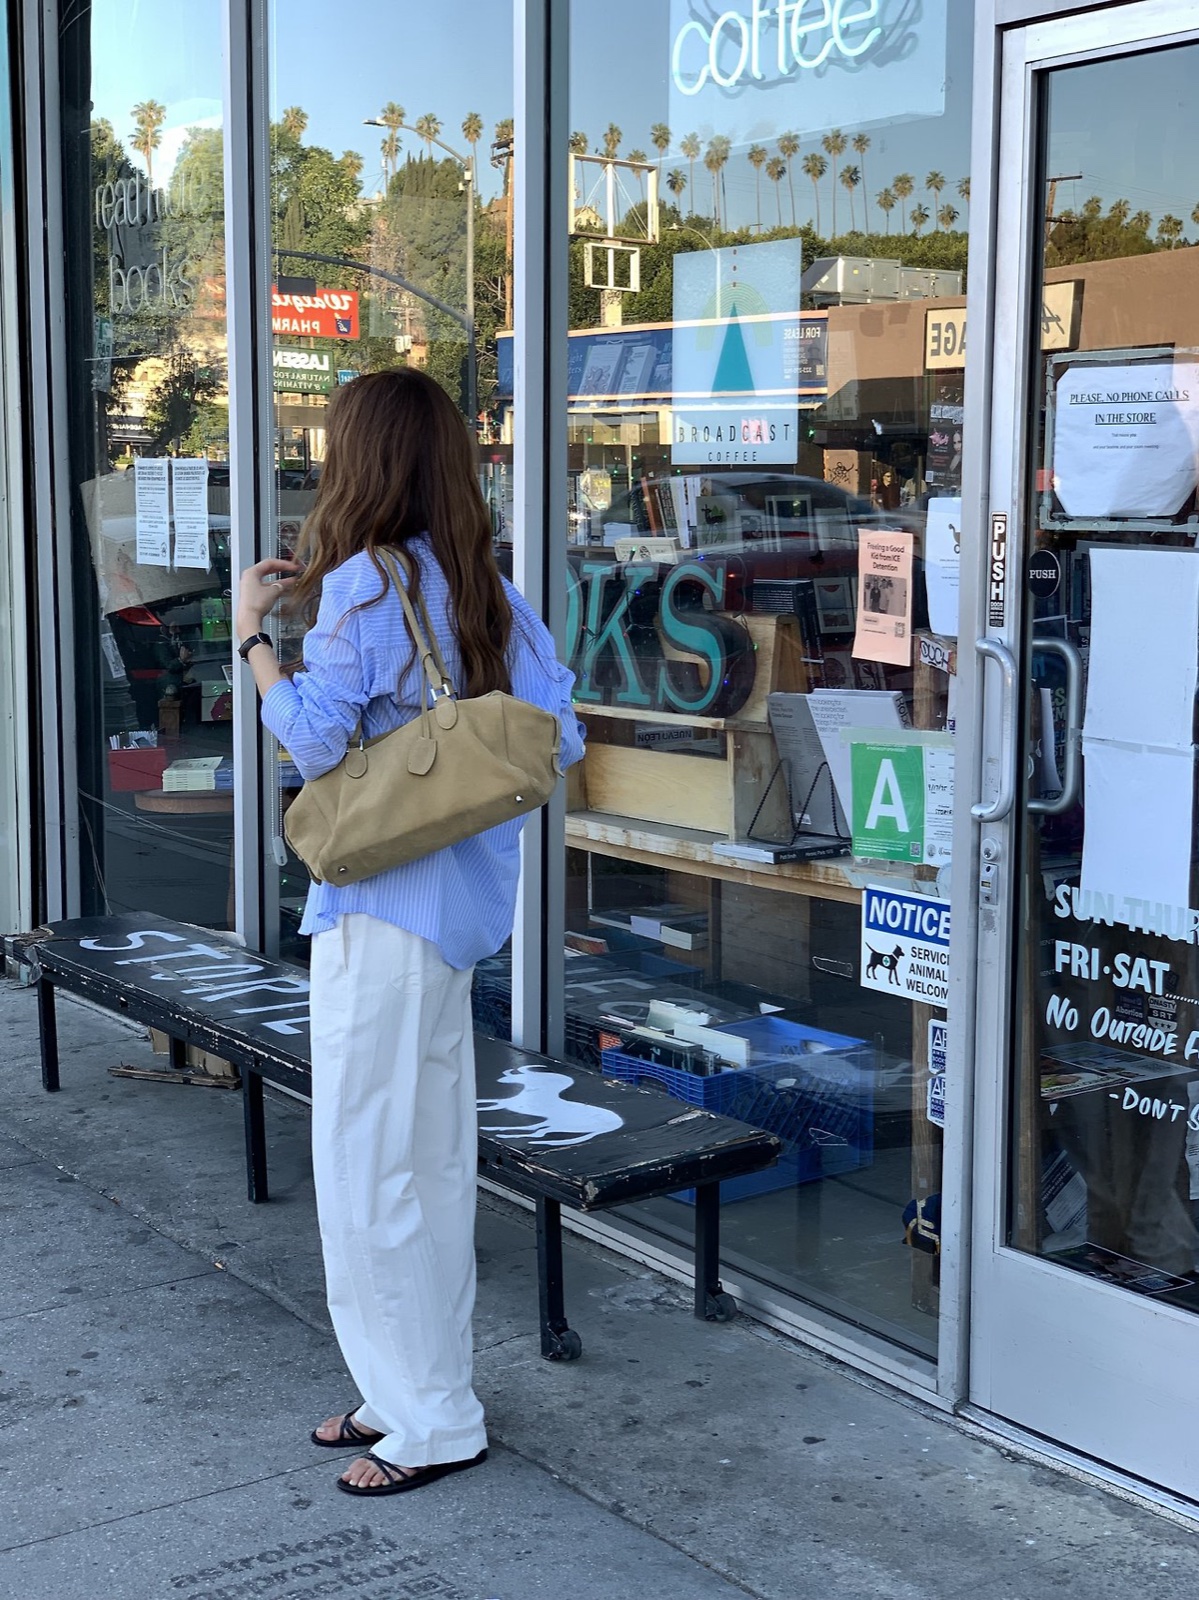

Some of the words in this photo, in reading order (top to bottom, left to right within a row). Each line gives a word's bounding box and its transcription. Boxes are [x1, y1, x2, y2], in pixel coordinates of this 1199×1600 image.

[672, 0, 881, 95] coffee
[96, 168, 145, 230] read
[110, 246, 195, 312] books
[1106, 392, 1120, 402] NO
[1121, 391, 1153, 402] PHONE
[1155, 389, 1190, 401] CALLS
[1095, 413, 1105, 423] IN
[1107, 413, 1126, 423] THE
[1127, 412, 1157, 423] STORE
[679, 424, 790, 443] BROADCAST
[708, 451, 757, 462] COFFEE
[870, 552, 879, 560] Kid
[879, 553, 892, 561] from
[892, 554, 901, 563] ICE
[890, 544, 905, 554] Good
[872, 562, 898, 572] Detention
[990, 521, 1006, 601] PUSH
[1029, 569, 1056, 579] PUSH
[864, 758, 910, 833] A
[869, 896, 951, 940] NOTICE
[169, 1524, 373, 1589] astrology
